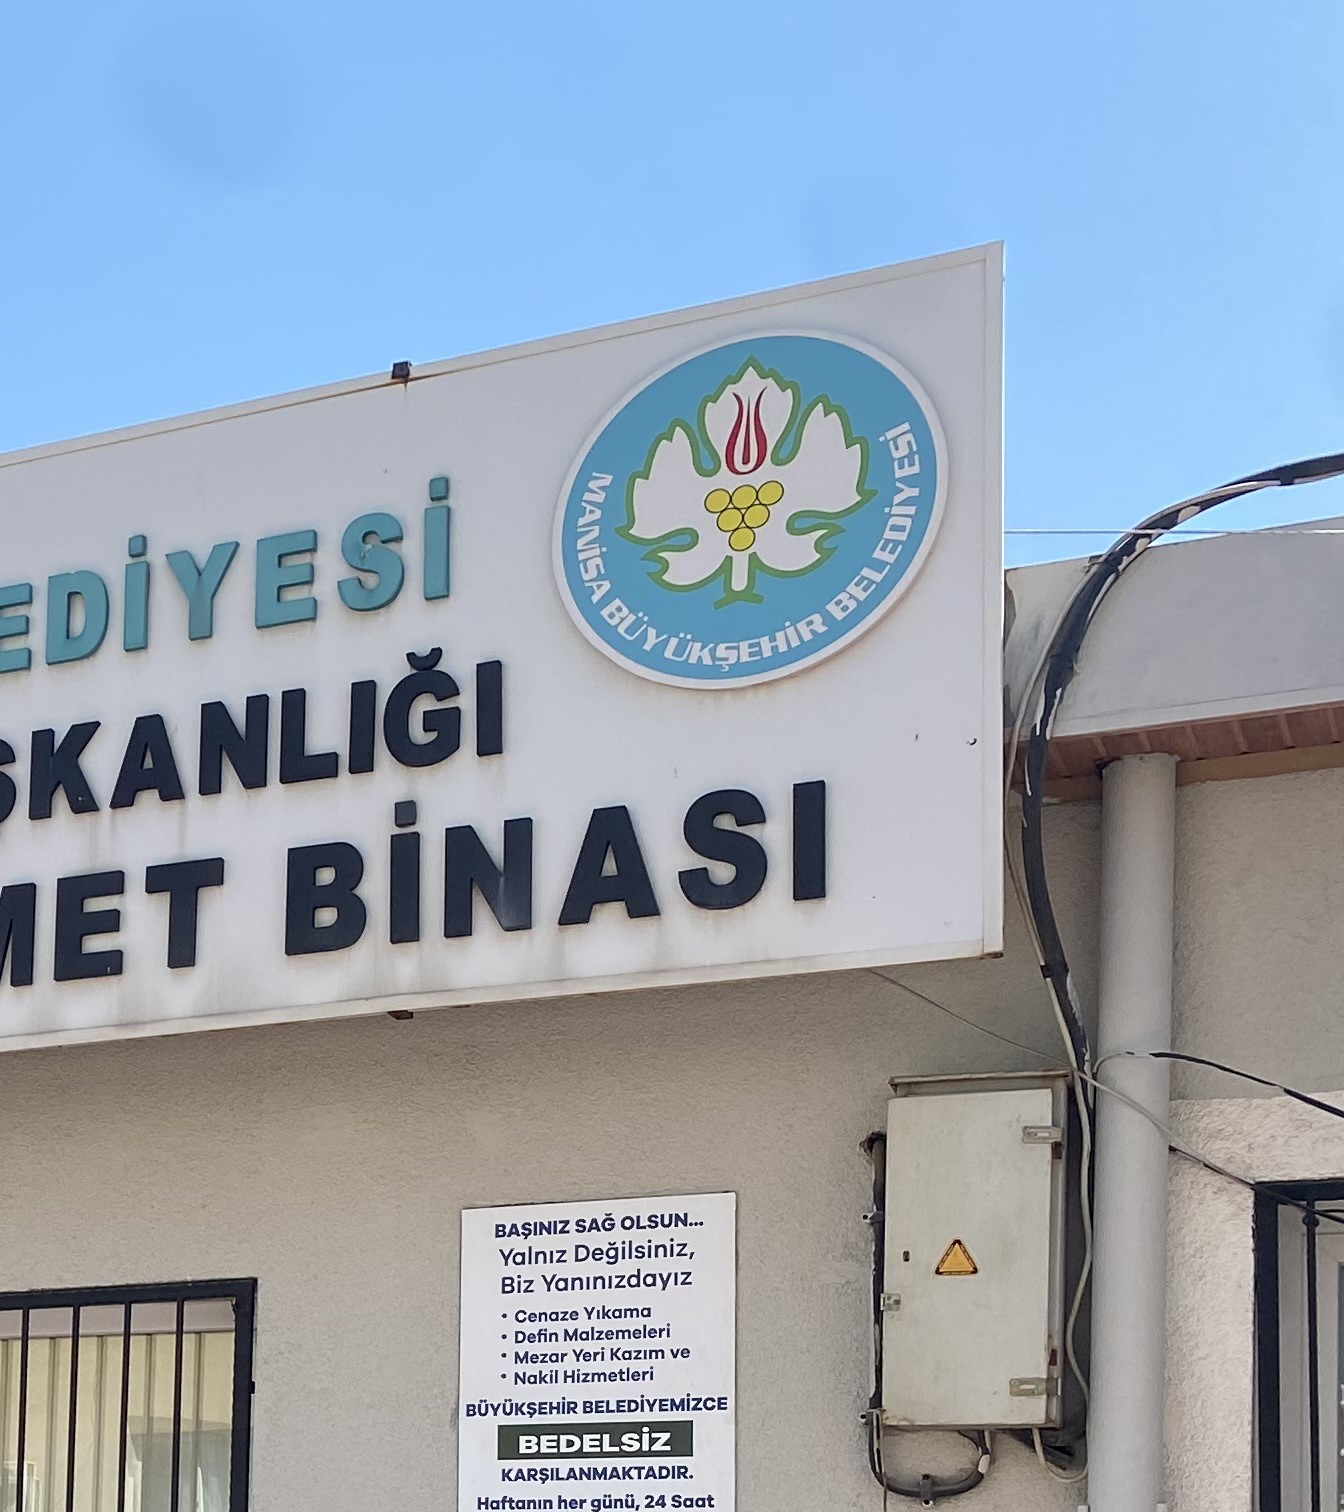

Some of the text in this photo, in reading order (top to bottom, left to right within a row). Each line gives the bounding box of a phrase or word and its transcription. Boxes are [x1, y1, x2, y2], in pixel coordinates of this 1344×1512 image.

[576, 421, 920, 672] MANİSA BÜYÜKŞEHİR BELEDİYESİ
[285, 780, 827, 956] BİNASI
[495, 1213, 704, 1239] BAŞINIZ SAĞ OLSUN...
[499, 1239, 695, 1267] Yalnız Değilsiniz,
[501, 1269, 693, 1294] Biz Yanınızdayız
[515, 1305, 652, 1323] Cenaze Yıkama
[514, 1323, 671, 1344] Defin Malzemeleri
[514, 1346, 691, 1365] Mezar Yeri Kazım ve
[514, 1367, 655, 1385] Nakil Hizmetleri
[466, 1393, 728, 1418] BÜYÜKŞEHİR BELEDİYEMİZCE
[518, 1426, 671, 1454] BEDELSİZ
[501, 1466, 694, 1483] KARŞILANMAKTADIR.
[477, 1494, 714, 1512] Haftanın her günü, 24 Saat
